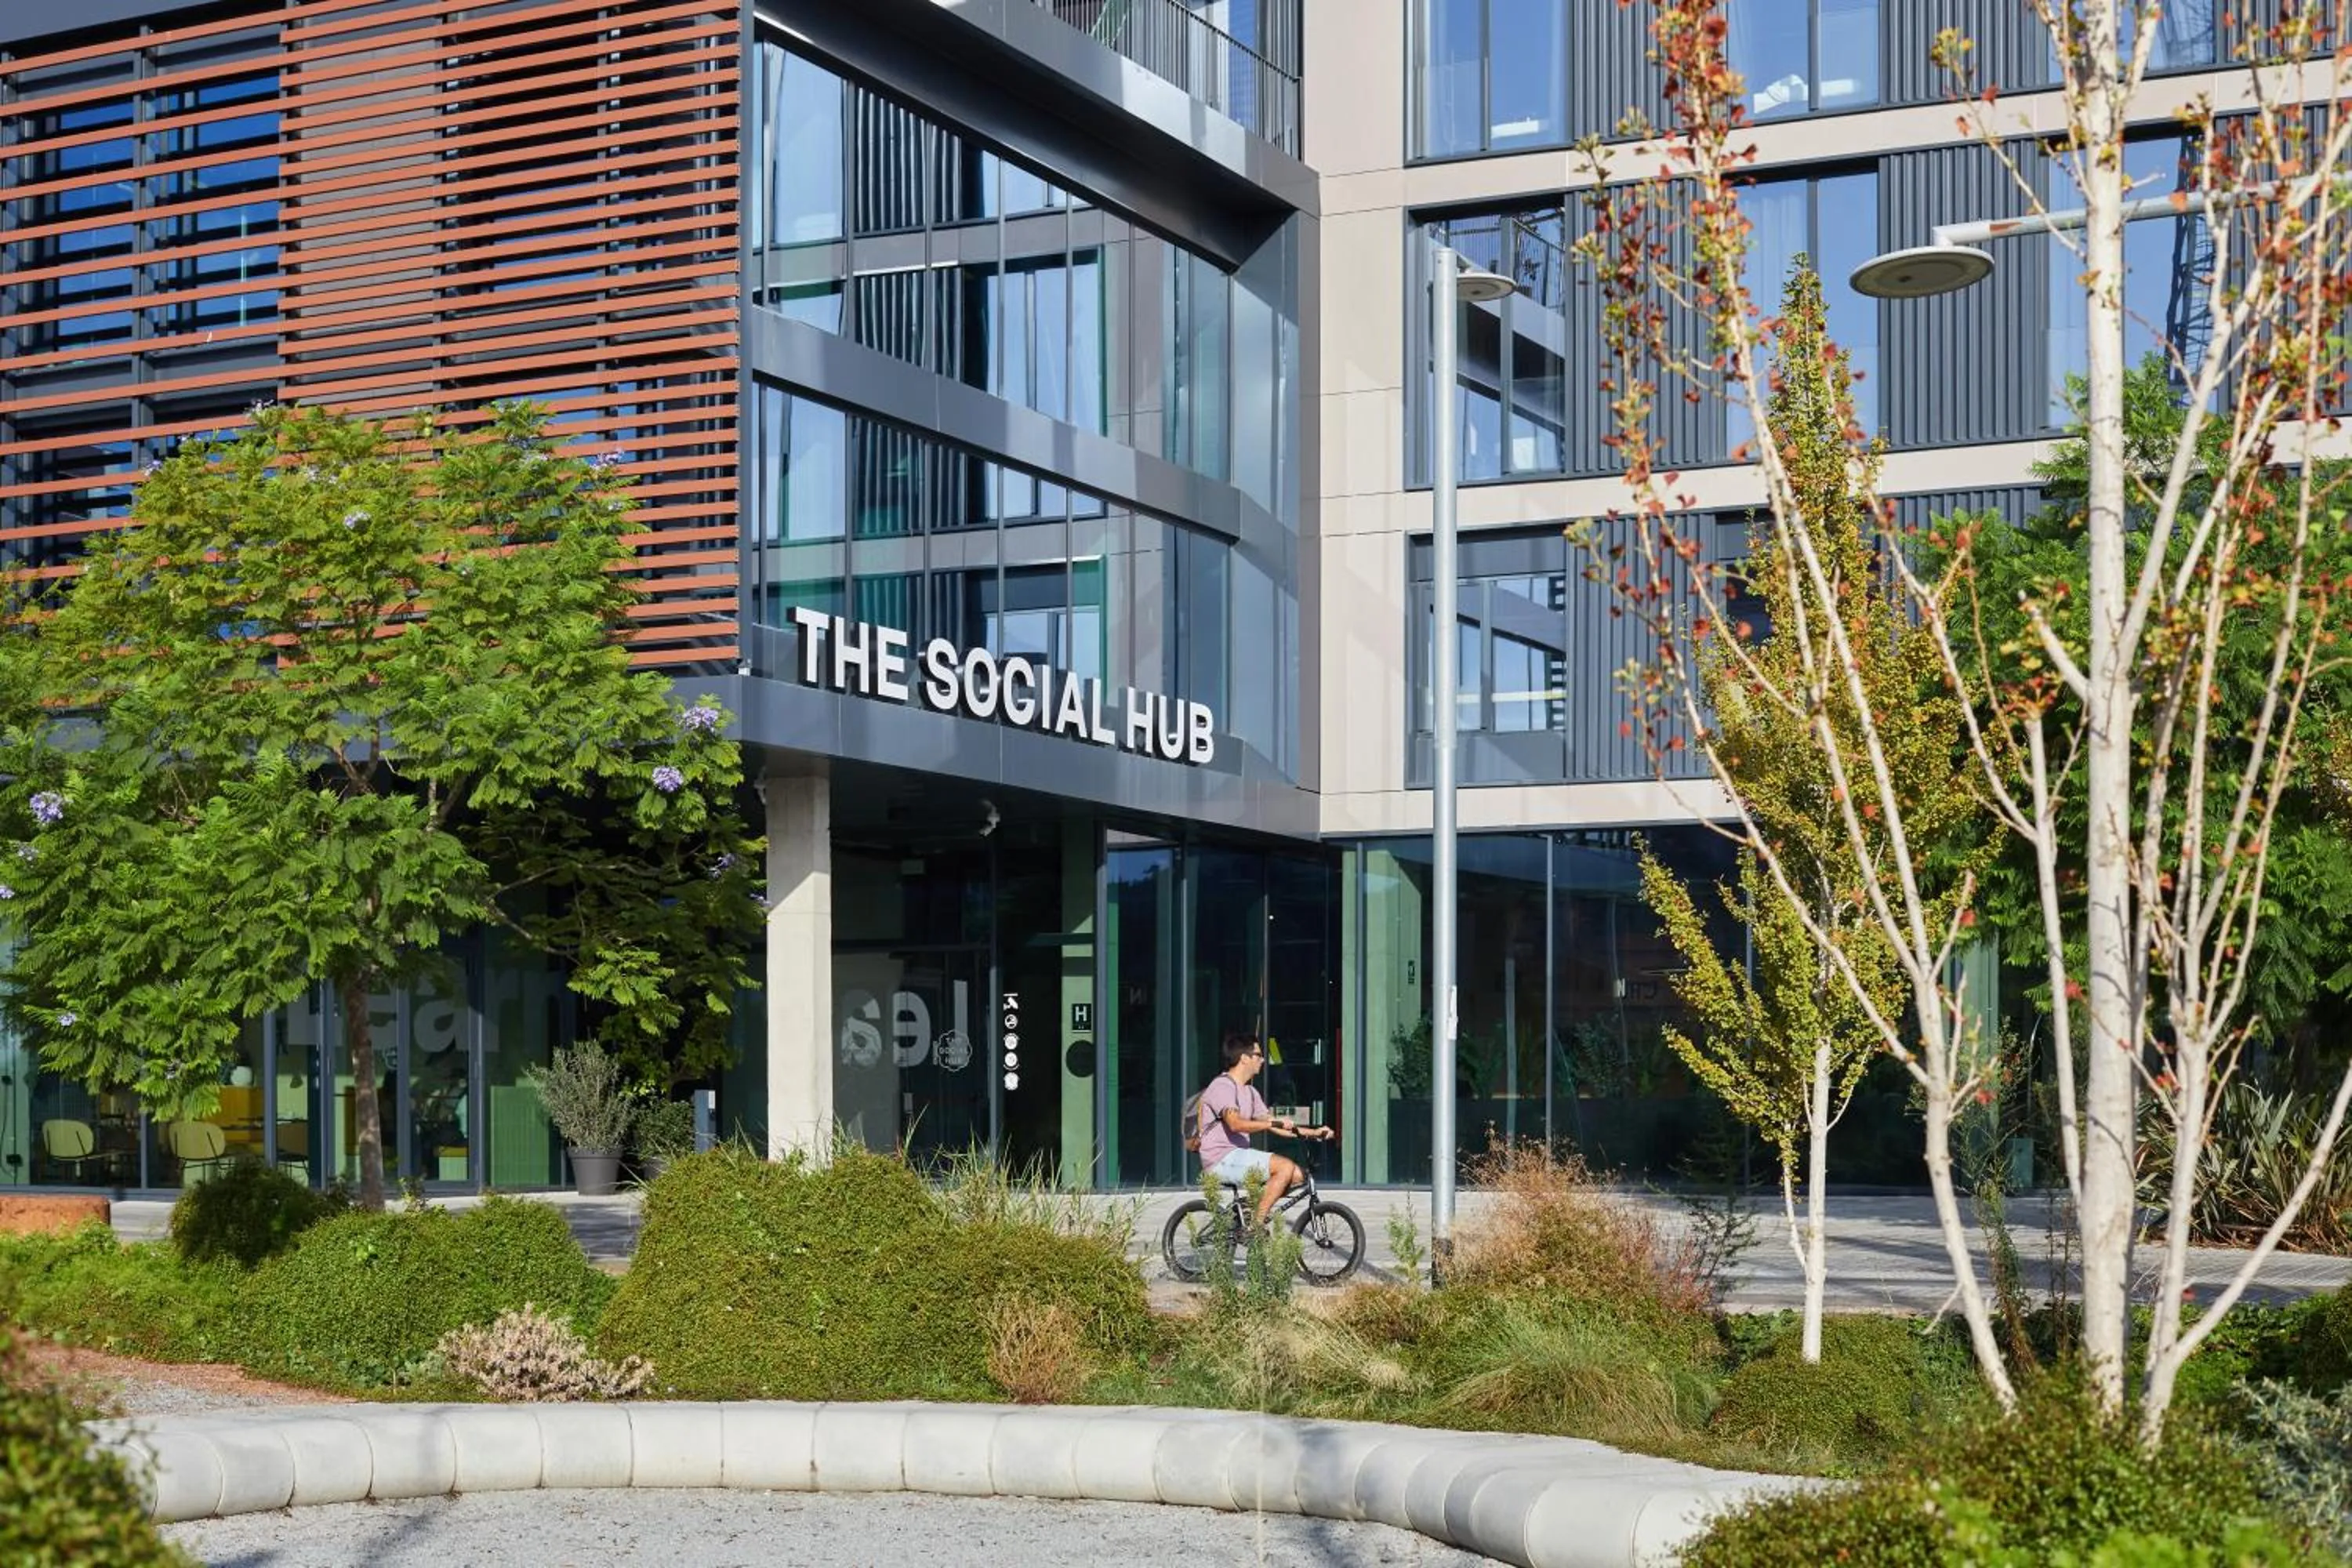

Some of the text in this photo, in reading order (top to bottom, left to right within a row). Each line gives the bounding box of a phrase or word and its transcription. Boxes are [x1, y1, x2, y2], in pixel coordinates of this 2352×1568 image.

[795, 606, 1215, 764] THE SOCIAL HUB
[1075, 1006, 1087, 1022] H
